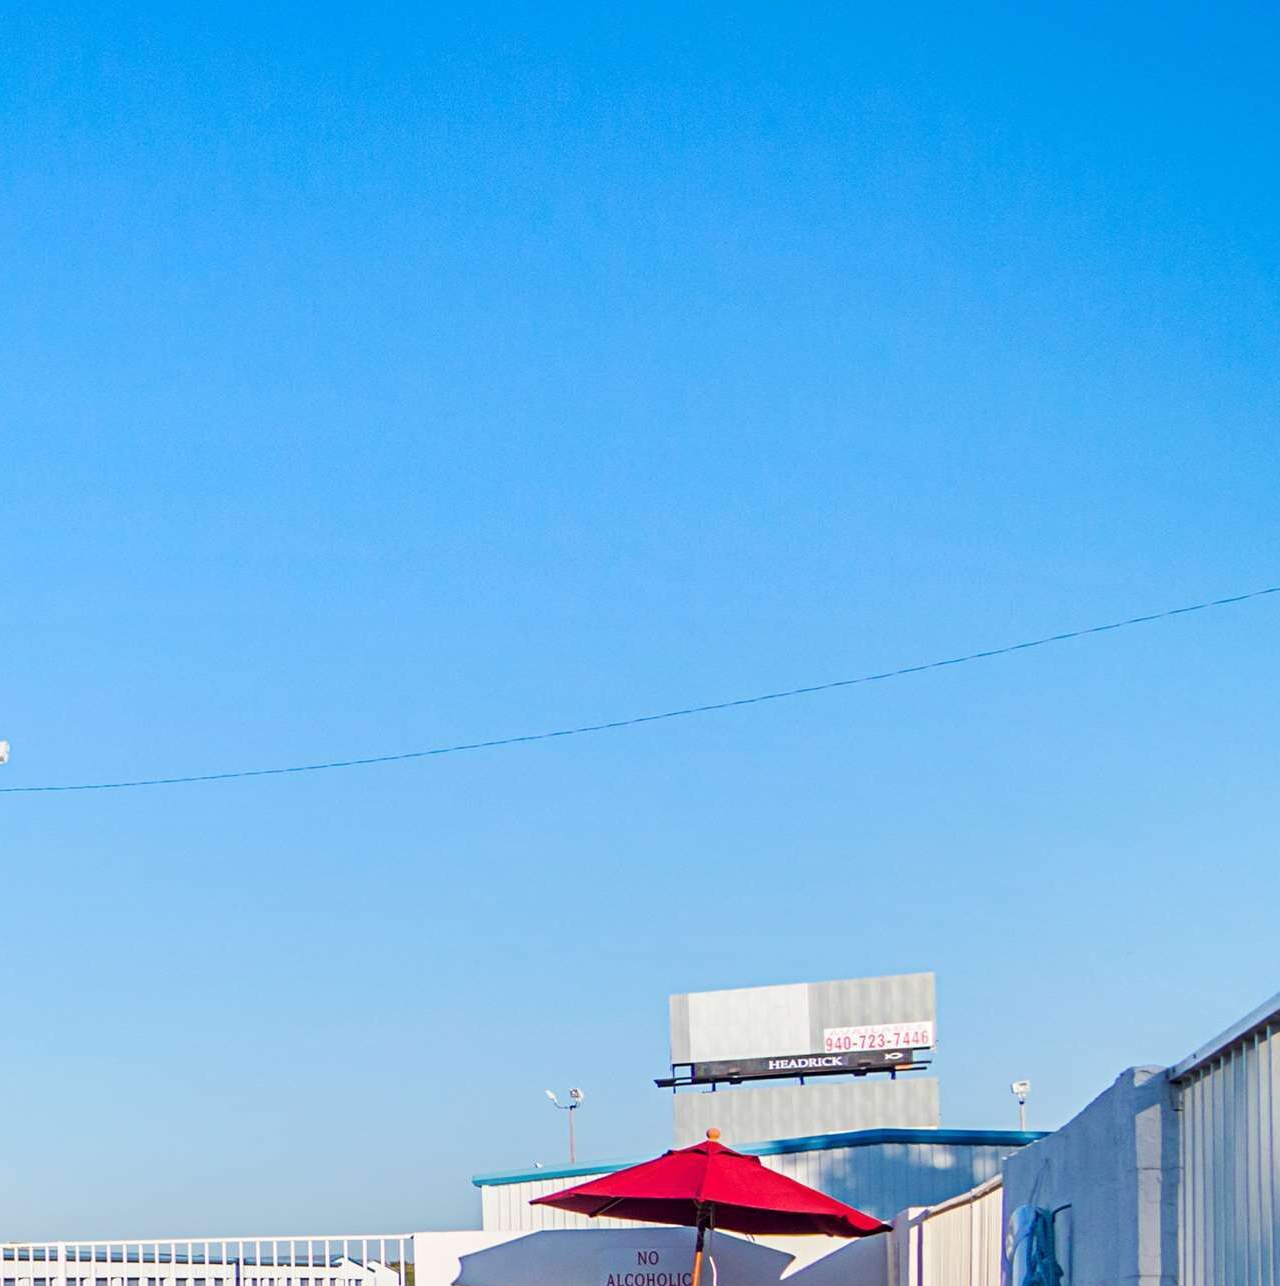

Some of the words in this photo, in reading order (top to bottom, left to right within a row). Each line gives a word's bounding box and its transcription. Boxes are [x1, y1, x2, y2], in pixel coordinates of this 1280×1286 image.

[825, 1031, 929, 1052] 940-723-7446
[768, 1056, 843, 1070] HEADRICK
[637, 1251, 659, 1265] NO
